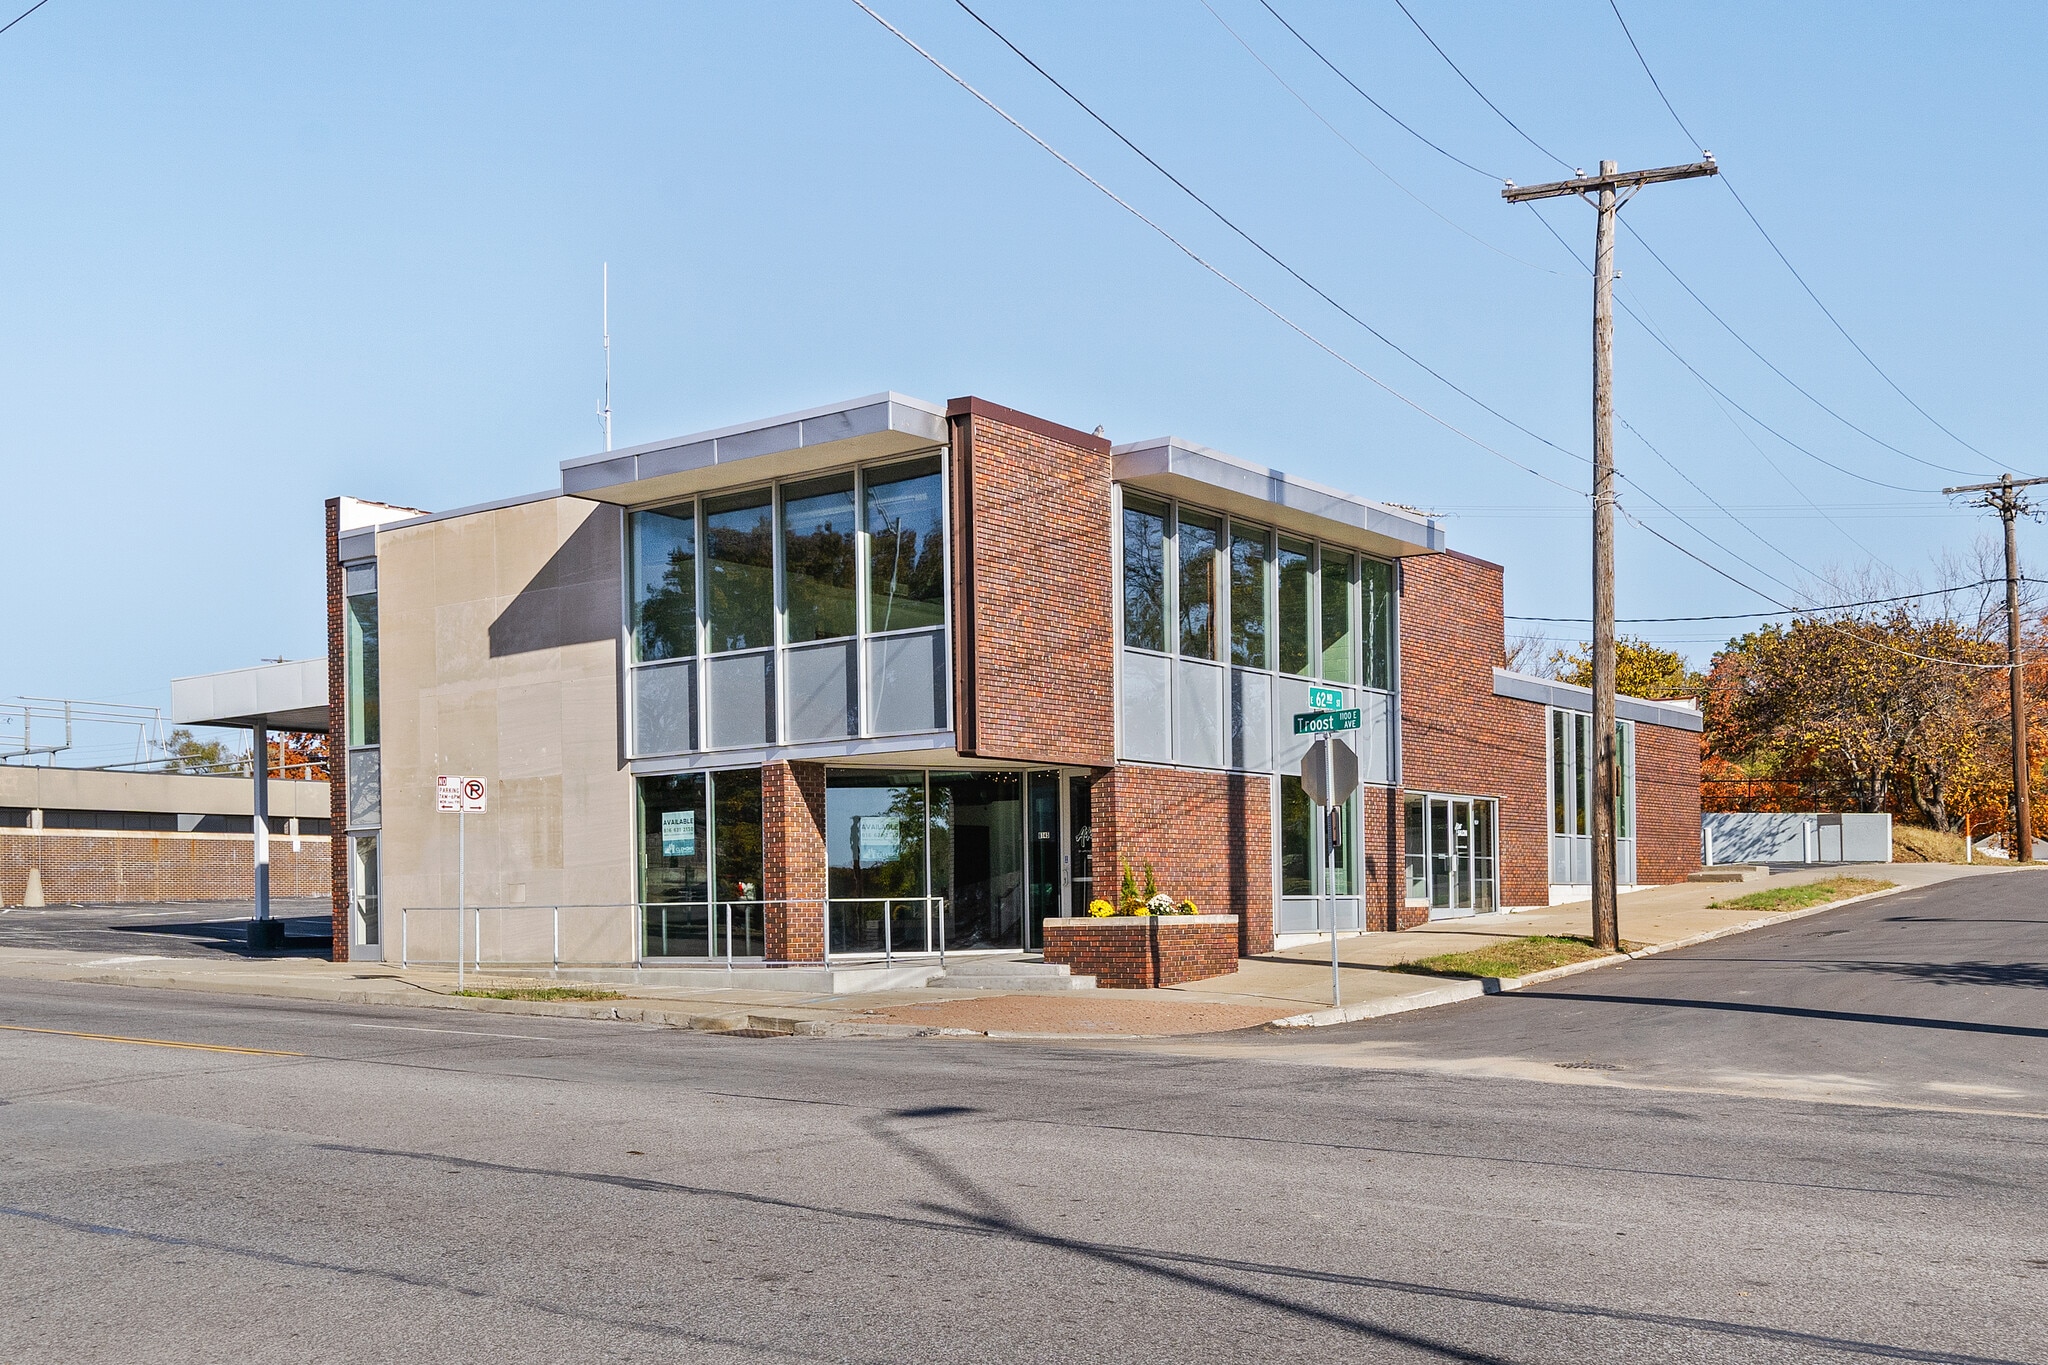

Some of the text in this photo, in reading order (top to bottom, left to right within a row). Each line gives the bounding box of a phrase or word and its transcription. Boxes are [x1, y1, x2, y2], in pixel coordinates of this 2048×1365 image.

[1310, 696, 1314, 705] E
[1335, 699, 1341, 708] ST
[1340, 711, 1357, 720] 1100 E
[1297, 715, 1334, 733] Troost
[1344, 719, 1357, 729] AVE
[438, 777, 446, 786] NO
[663, 817, 694, 826] AVAILABLE
